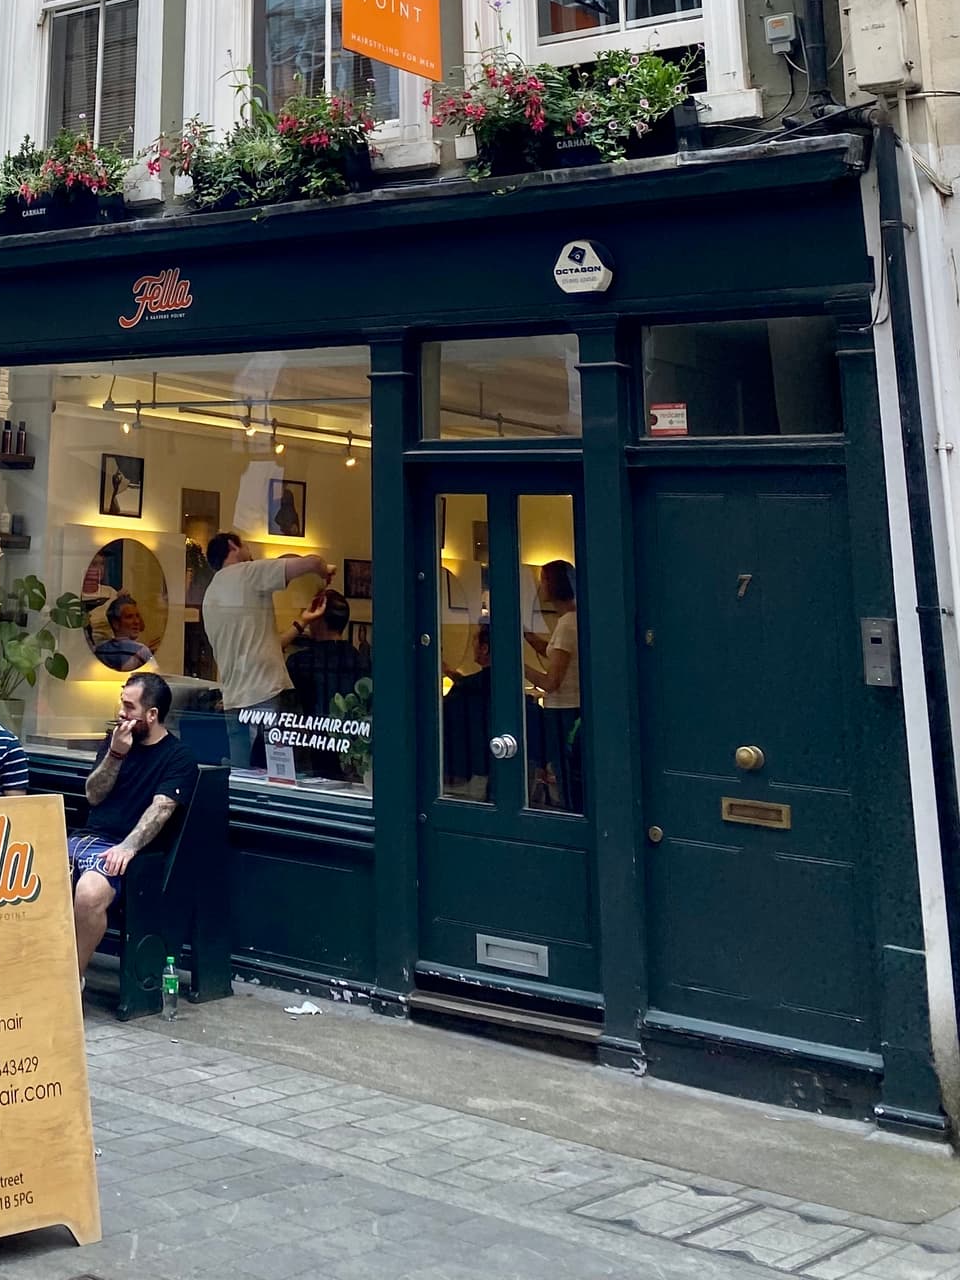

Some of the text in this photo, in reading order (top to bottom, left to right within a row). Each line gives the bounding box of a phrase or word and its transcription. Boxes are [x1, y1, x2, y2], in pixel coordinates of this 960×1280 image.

[351, 32, 435, 69] HAIRSTYLING FOR MEN
[556, 138, 594, 149] CARNAB
[555, 266, 601, 275] OCTAGON
[118, 267, 193, 328] Fella
[737, 574, 752, 597] 7
[238, 709, 371, 738] WWW.FELLAHAIR.COM
[268, 728, 350, 753] @FELLAHAIR
[0, 912, 26, 921] POINT
[13, 1190, 34, 1208] 5PG
